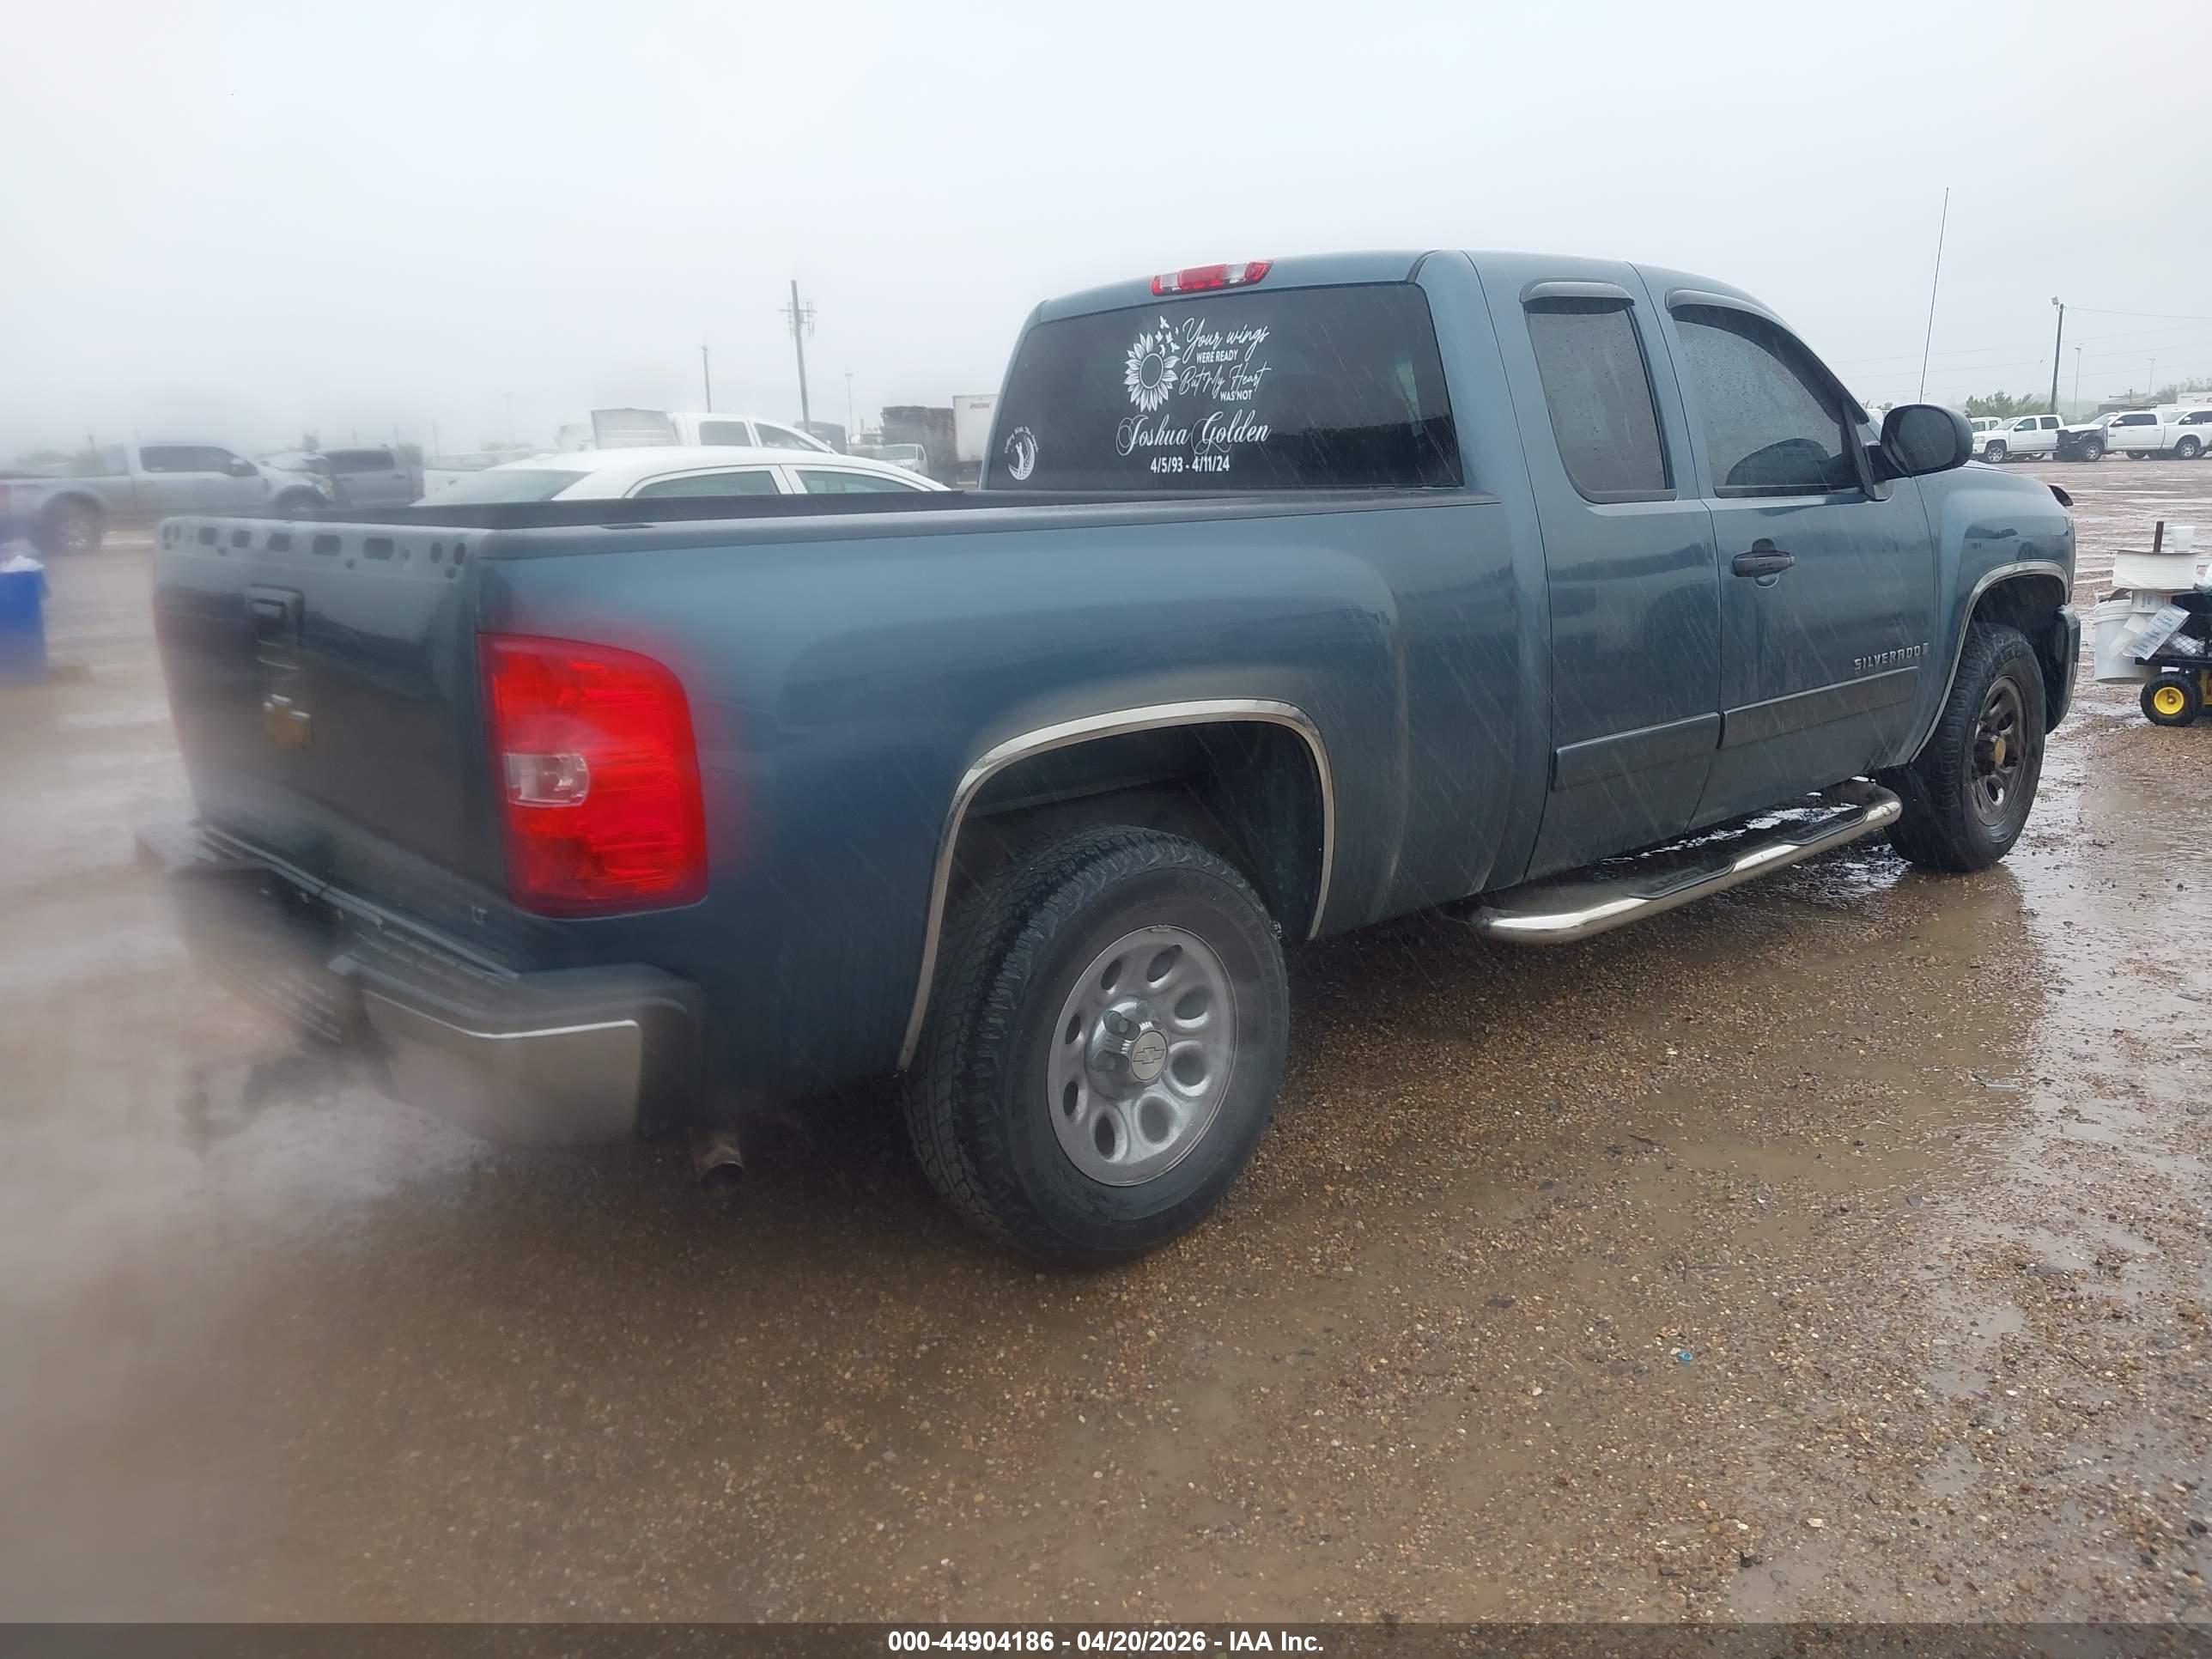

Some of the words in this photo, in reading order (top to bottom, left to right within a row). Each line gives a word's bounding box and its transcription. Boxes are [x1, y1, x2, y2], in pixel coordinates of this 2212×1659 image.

[1182, 318, 1224, 364] Your
[1226, 324, 1270, 362] wings
[1196, 351, 1214, 363] WERE
[1215, 349, 1238, 362] READY
[1178, 365, 1206, 397] But
[1202, 364, 1225, 399] My
[1229, 361, 1272, 395] Heart
[1220, 391, 1236, 402] WAS
[1237, 389, 1253, 401] NOT
[1115, 414, 1192, 456] Joshua
[1190, 408, 1273, 456] Golden
[1150, 456, 1183, 473] 4/5/93
[1192, 455, 1231, 473] 4/11/24
[1854, 645, 1921, 671] SILVERADO
